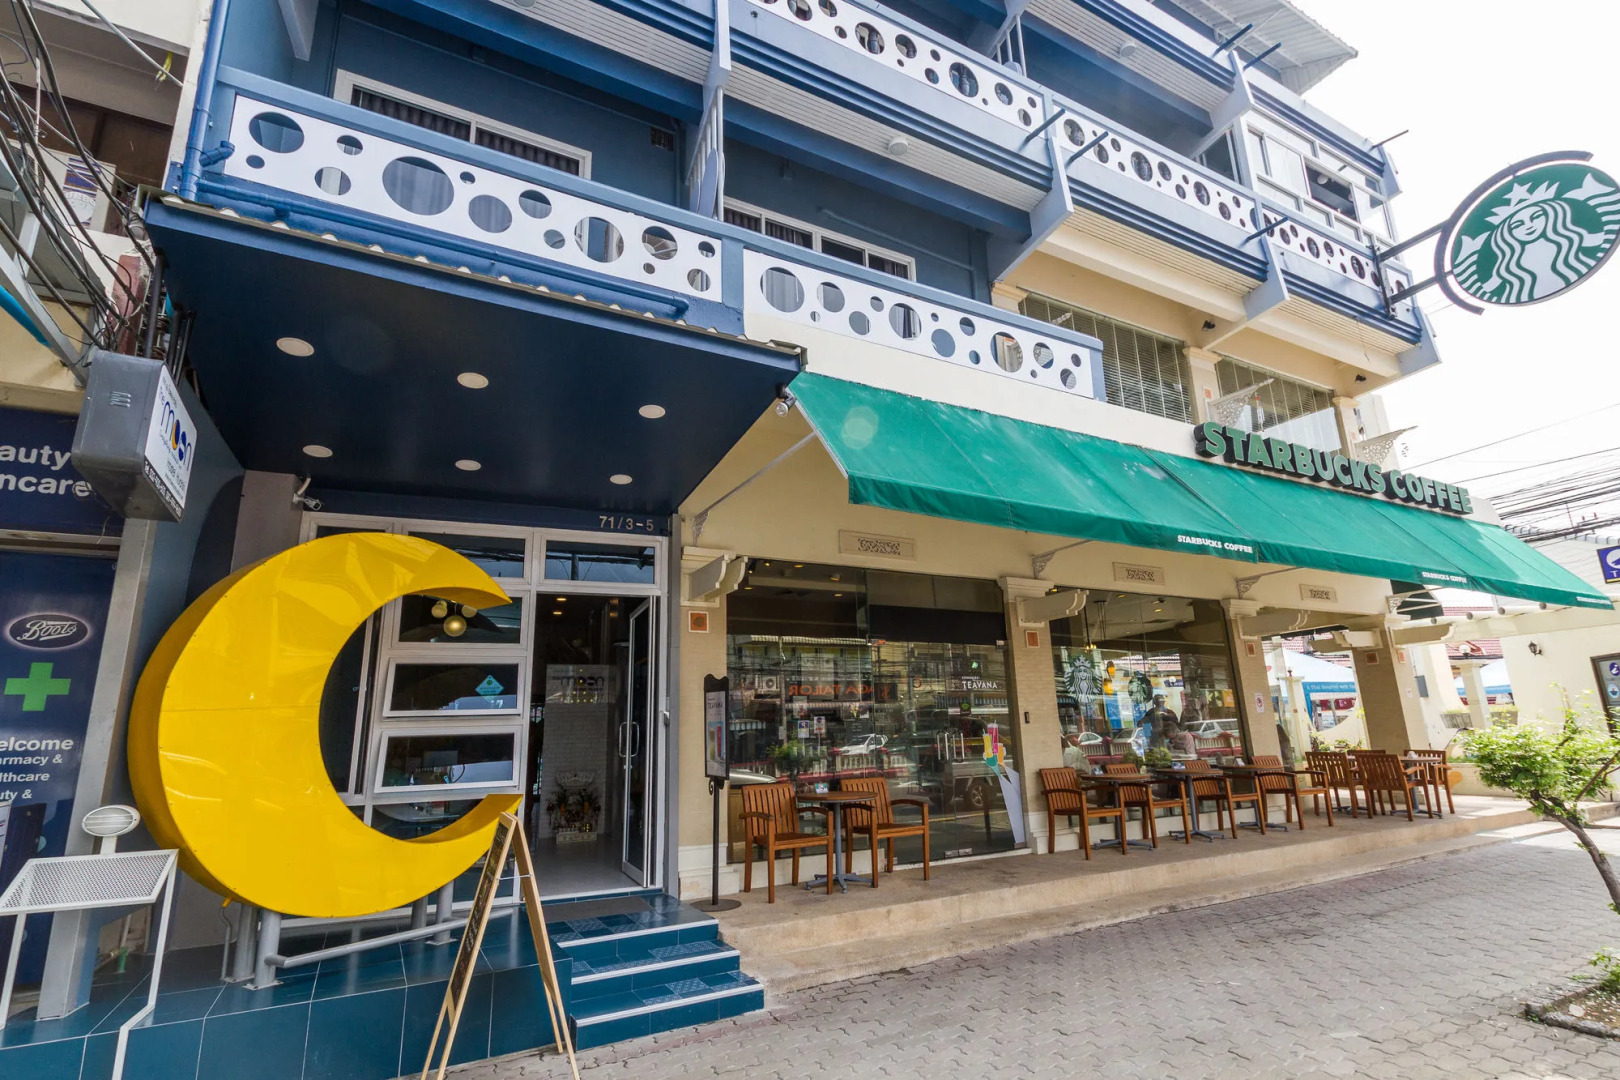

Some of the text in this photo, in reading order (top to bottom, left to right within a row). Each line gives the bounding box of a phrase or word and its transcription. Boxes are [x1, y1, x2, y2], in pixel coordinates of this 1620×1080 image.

[1204, 421, 1474, 514] STARBUCKS COFFEE
[599, 515, 654, 531] 71/3-5
[1177, 534, 1254, 554] STARBUCKS COFFEE
[16, 620, 77, 641] Boots
[961, 681, 998, 689] TEAVANA
[52, 754, 63, 764] &
[22, 789, 33, 799] &
